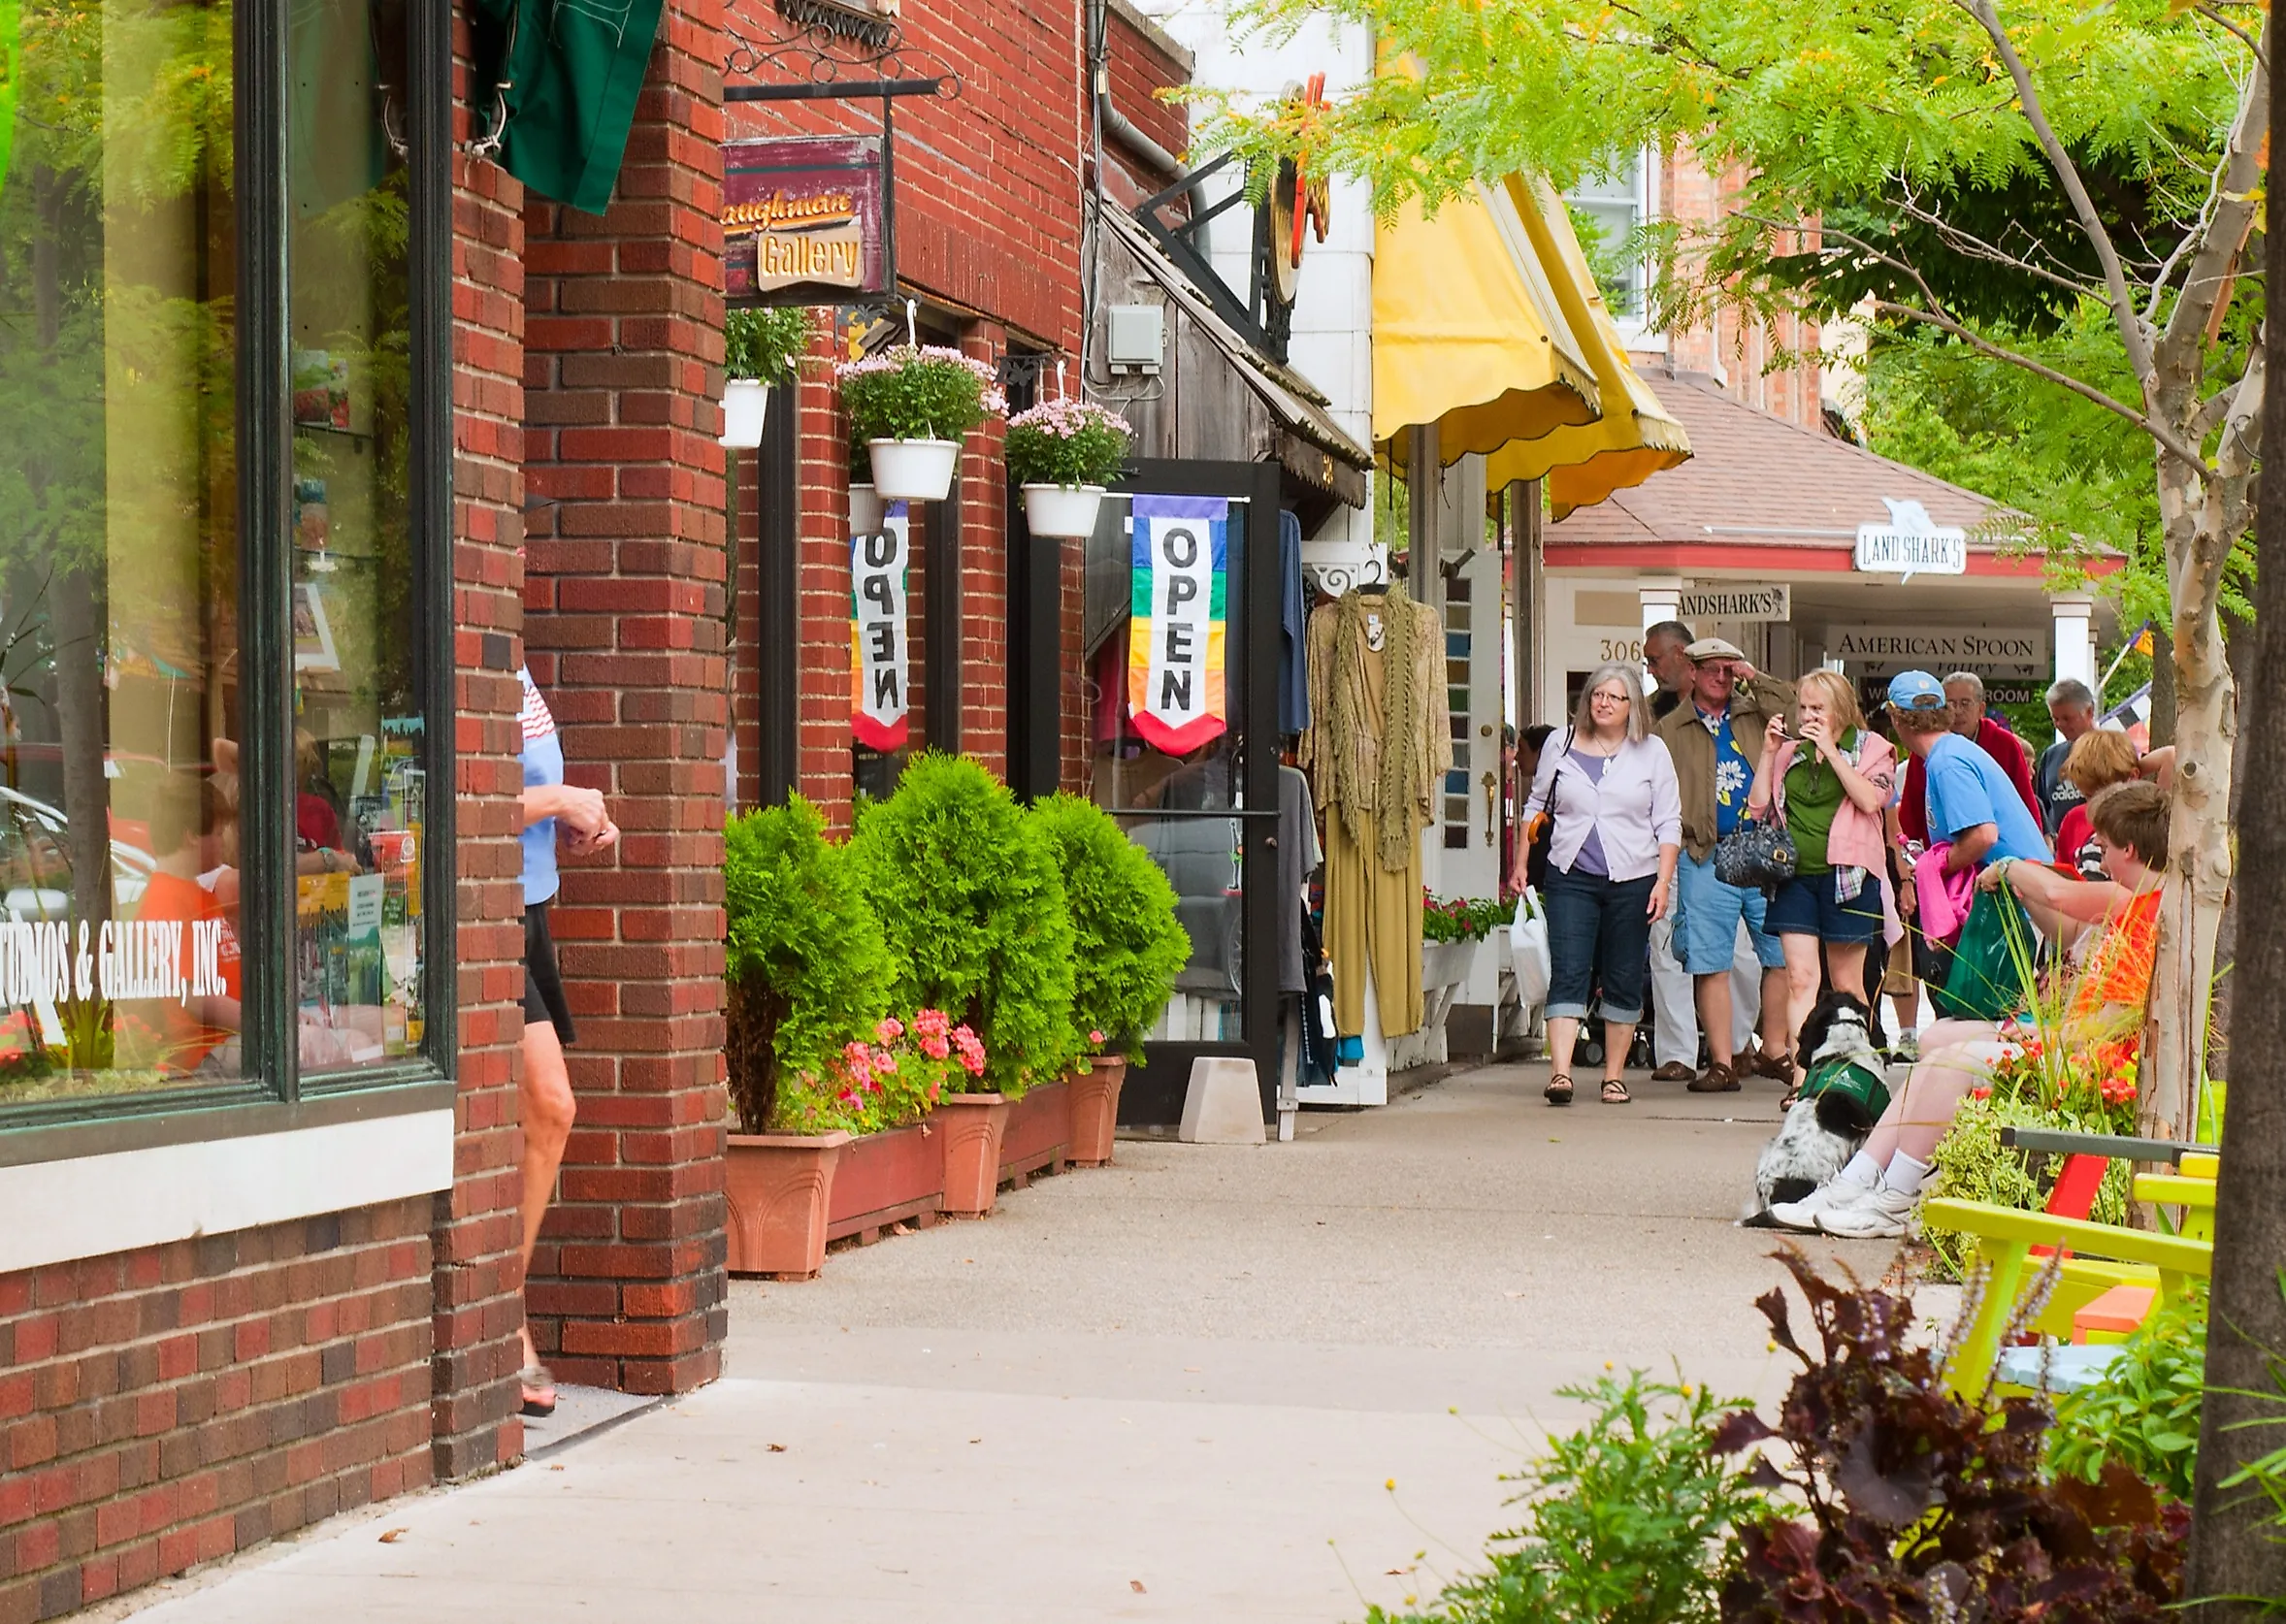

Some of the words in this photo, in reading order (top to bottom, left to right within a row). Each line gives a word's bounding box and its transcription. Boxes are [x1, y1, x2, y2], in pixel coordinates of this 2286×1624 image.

[720, 189, 852, 231] aughman
[761, 236, 859, 281] Gallery
[1160, 527, 1198, 711] OPEN
[1677, 593, 1772, 616] ANDSHARK'S
[1601, 639, 1642, 662] 306
[1839, 633, 1956, 655] AMERICAN
[1963, 634, 2033, 657] SPOON
[1983, 689, 2030, 702] ROOM
[0, 921, 69, 1005] TUDIOS
[75, 920, 93, 1002] &
[99, 919, 187, 1008] GALLERY,
[192, 920, 227, 996] INC.
